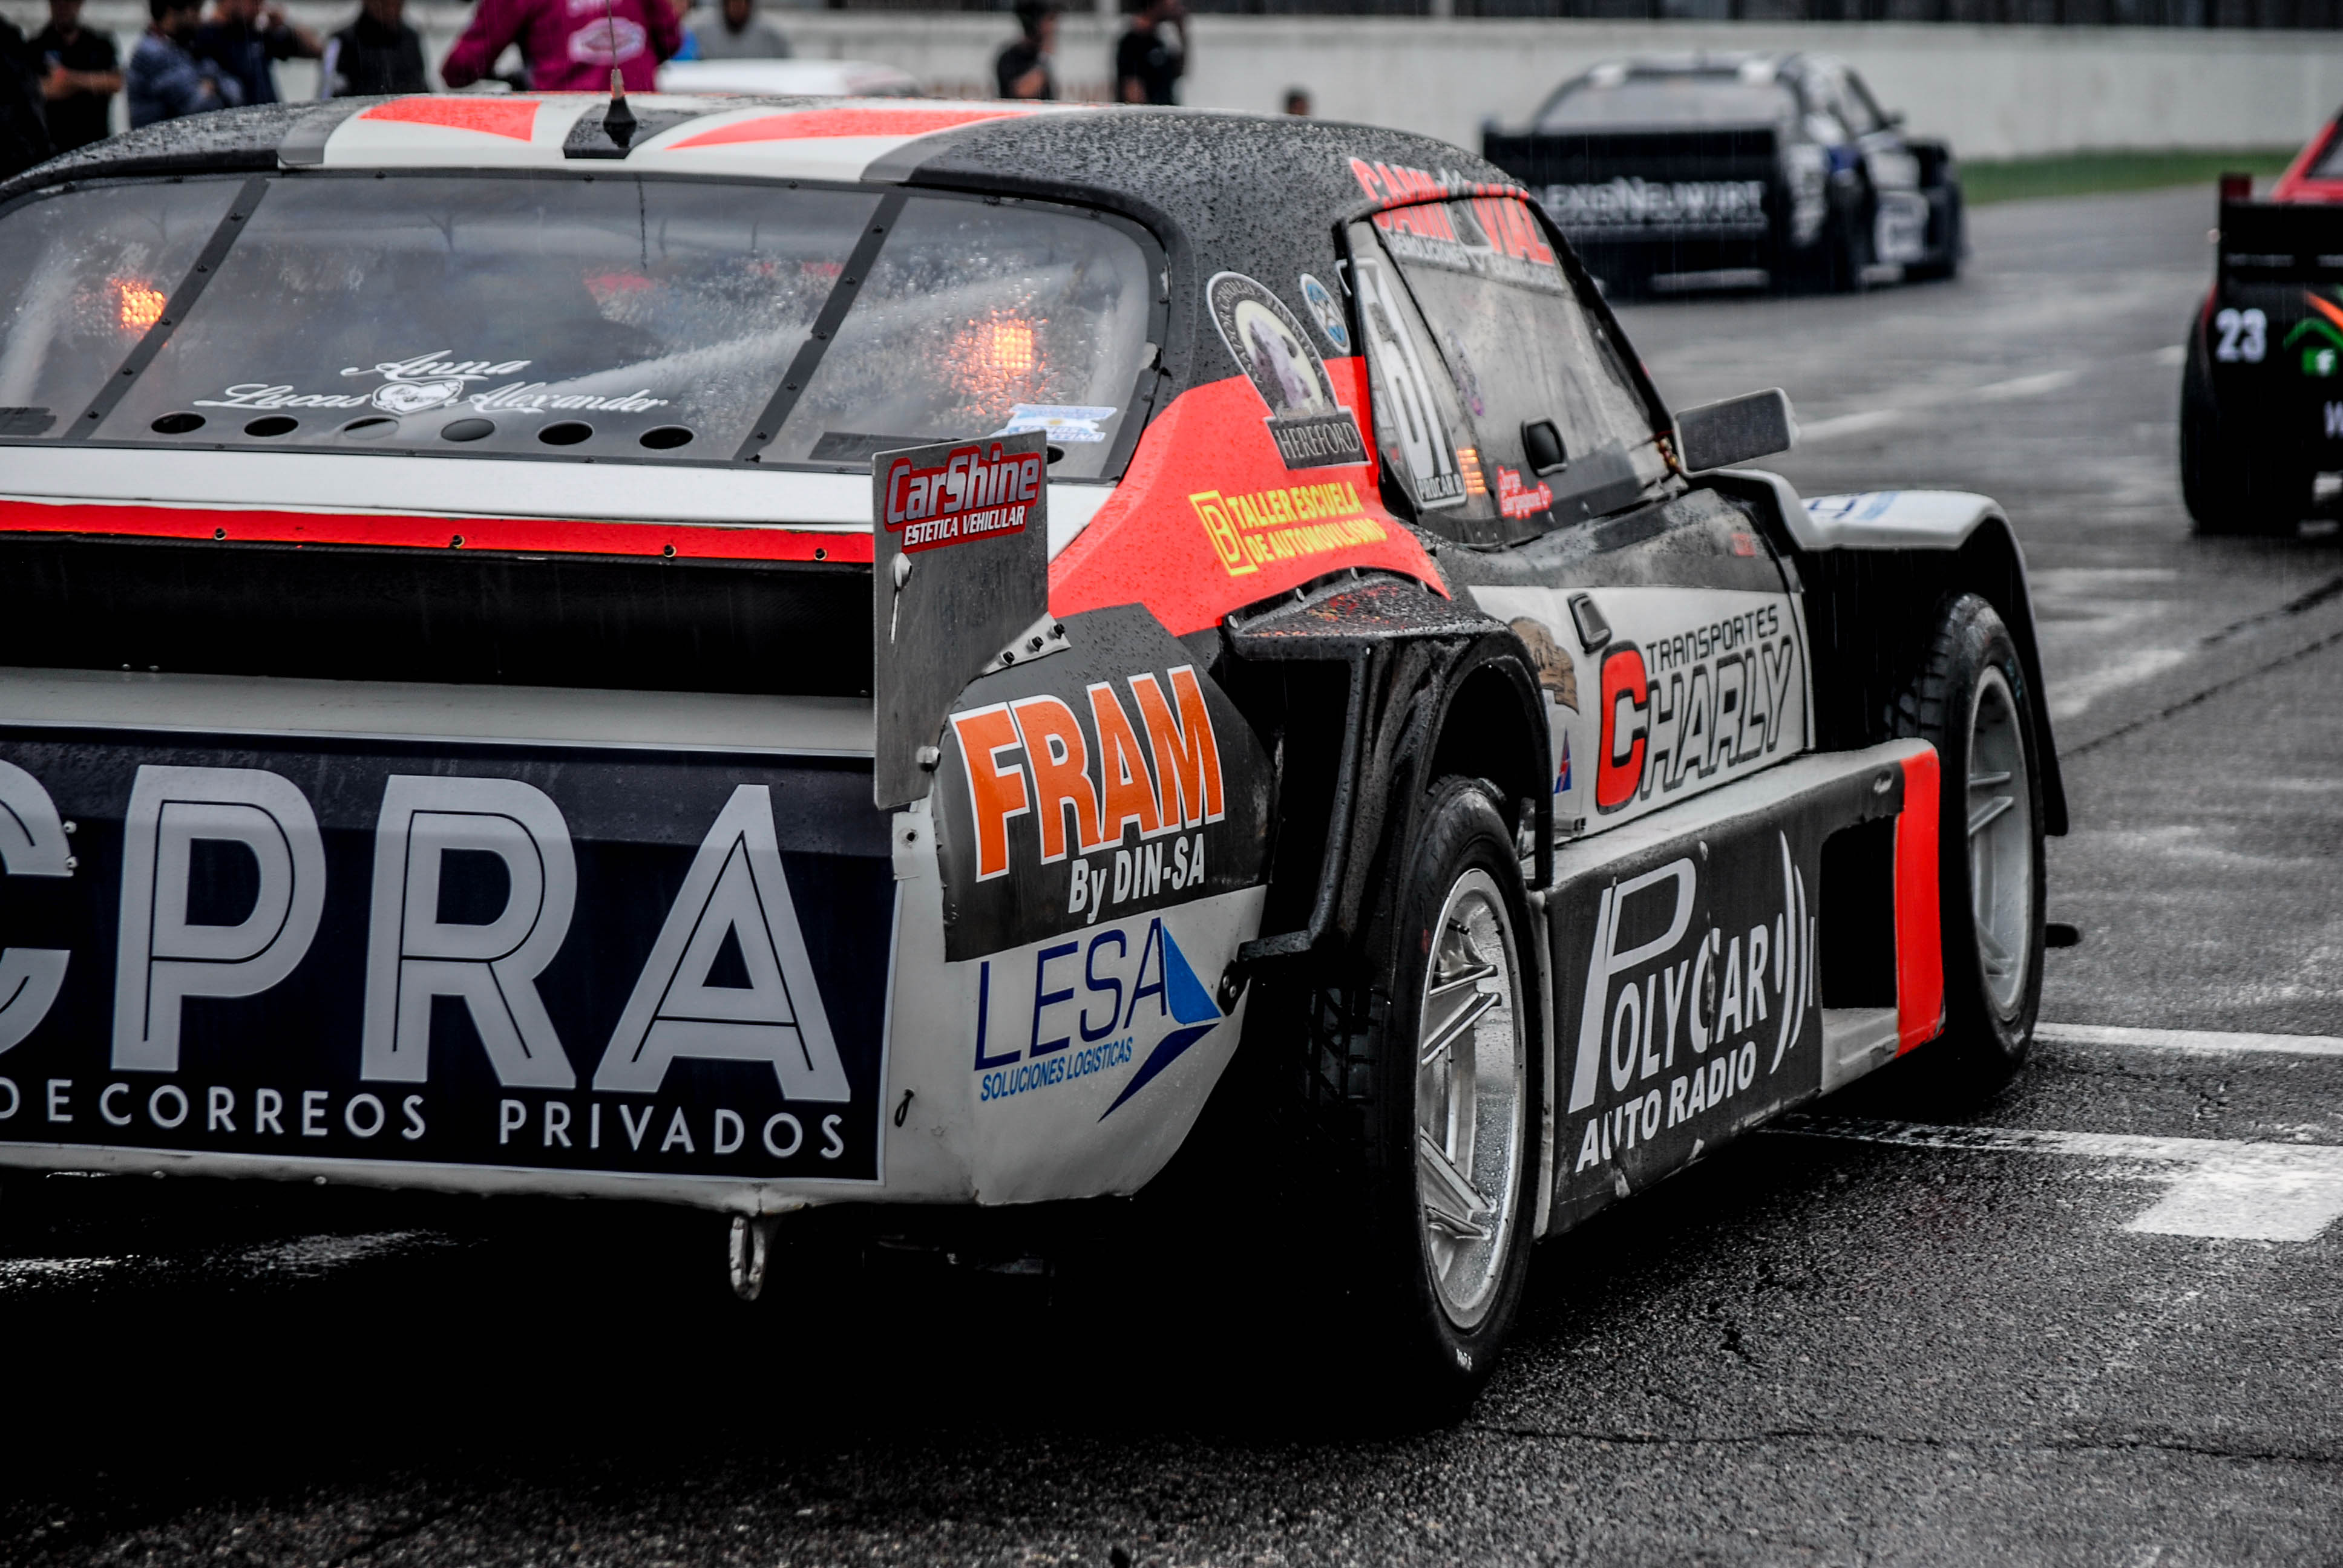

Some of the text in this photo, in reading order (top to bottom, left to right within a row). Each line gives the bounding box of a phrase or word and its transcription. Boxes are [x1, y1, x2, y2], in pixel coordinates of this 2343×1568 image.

[341, 350, 531, 381] Anna
[2215, 307, 2267, 364] 23
[192, 383, 372, 410] Lucas
[453, 381, 669, 414] Alexander
[1275, 422, 1360, 460] HEREFORD
[886, 449, 1040, 524] CarShine
[1226, 482, 1365, 529] TALLER ESCUELA
[1417, 474, 1463, 500] PROCAR B
[904, 505, 1025, 546] ESTETICA VEHICULAR
[1244, 518, 1388, 563] DE AUTOMOVILISMO
[1647, 603, 1778, 674] TRANSPORTES
[1596, 635, 1794, 815] CHARLY
[949, 664, 1225, 883] FRAM
[1067, 832, 1205, 924] By DIN-SA
[974, 916, 1167, 1071] LESA
[980, 1036, 1133, 1102] SOLUCIONES LOGISTICAS
[99, 1082, 427, 1141] CORREOS
[500, 1099, 844, 1159] PRIVADOS
[1575, 1040, 1756, 1173] AUTO RADIO
